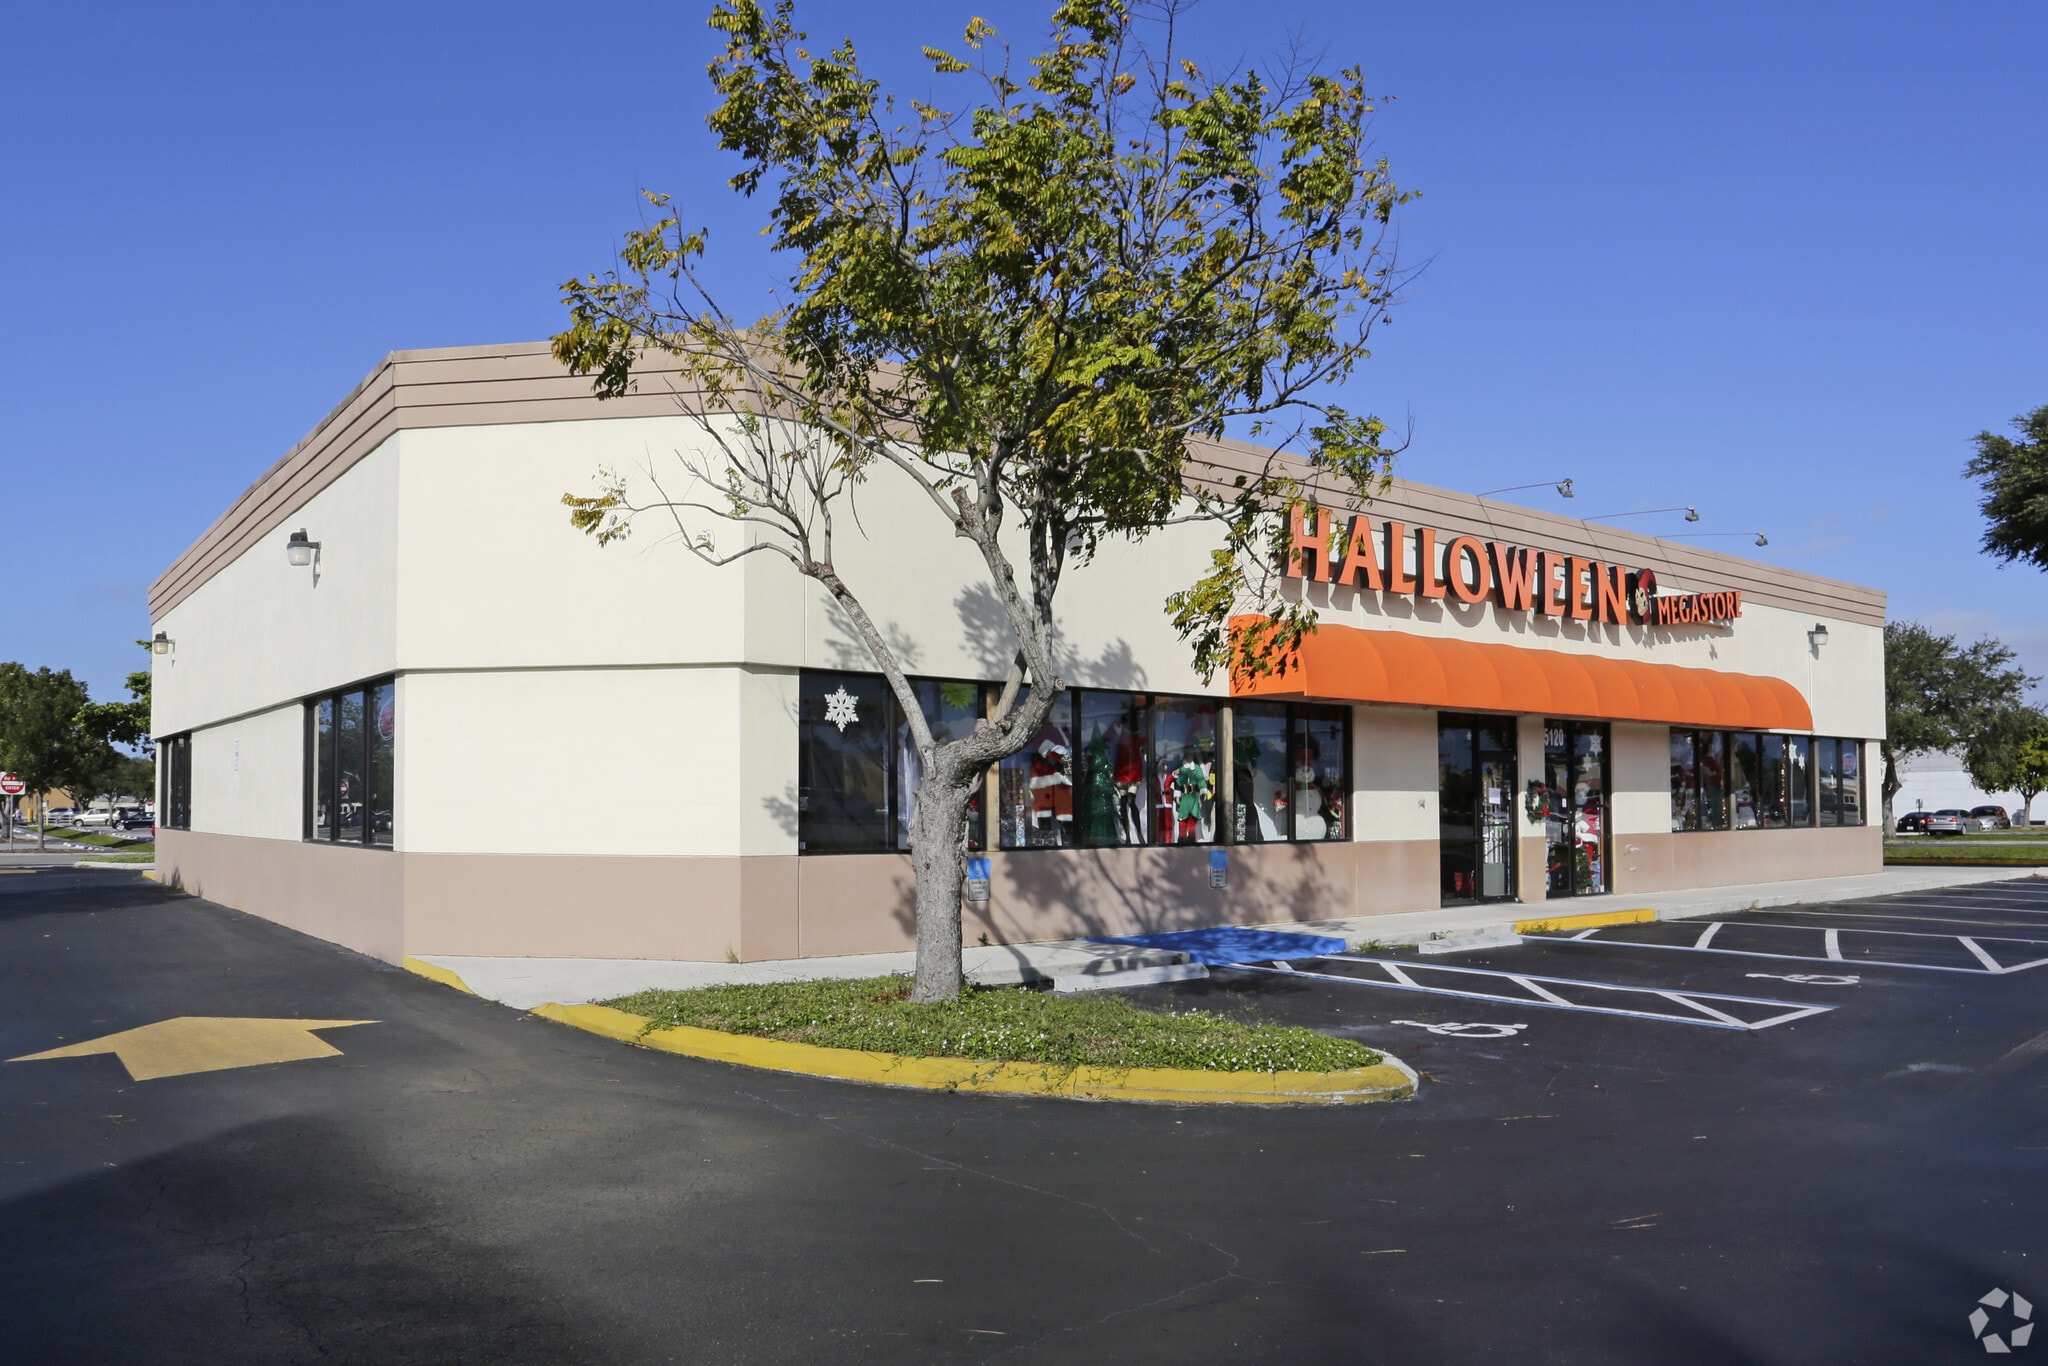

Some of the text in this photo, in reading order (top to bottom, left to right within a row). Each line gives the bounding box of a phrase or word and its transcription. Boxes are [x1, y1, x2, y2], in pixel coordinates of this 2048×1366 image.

[1284, 503, 1742, 625] HALLOWEEN MEGASTORE
[1544, 728, 1564, 746] 5120
